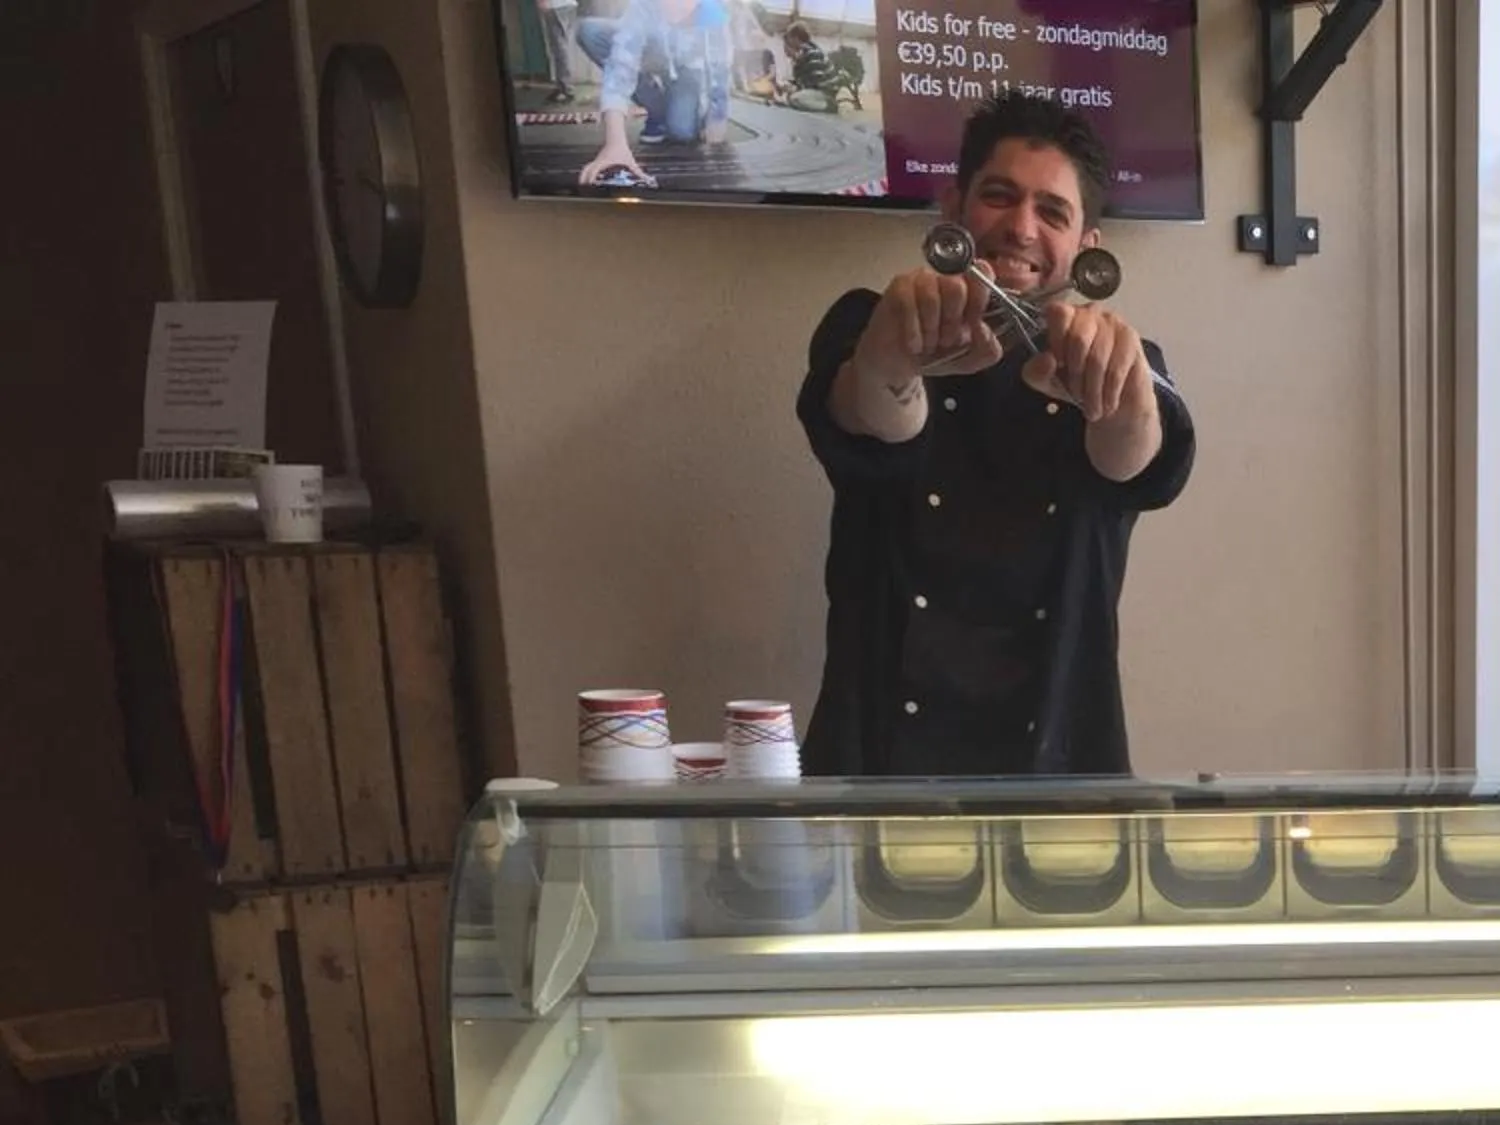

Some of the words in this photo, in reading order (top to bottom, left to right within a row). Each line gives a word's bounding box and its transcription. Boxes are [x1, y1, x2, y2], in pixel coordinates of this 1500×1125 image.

[896, 10, 939, 35] Kids
[944, 14, 972, 38] for
[978, 16, 1016, 41] free
[1036, 23, 1168, 56] zondagmiddag
[898, 43, 967, 69] €39,50
[973, 50, 1009, 74] p.p.
[900, 73, 943, 97] Kids
[949, 77, 983, 101] t/m
[1061, 85, 1112, 109] gratis
